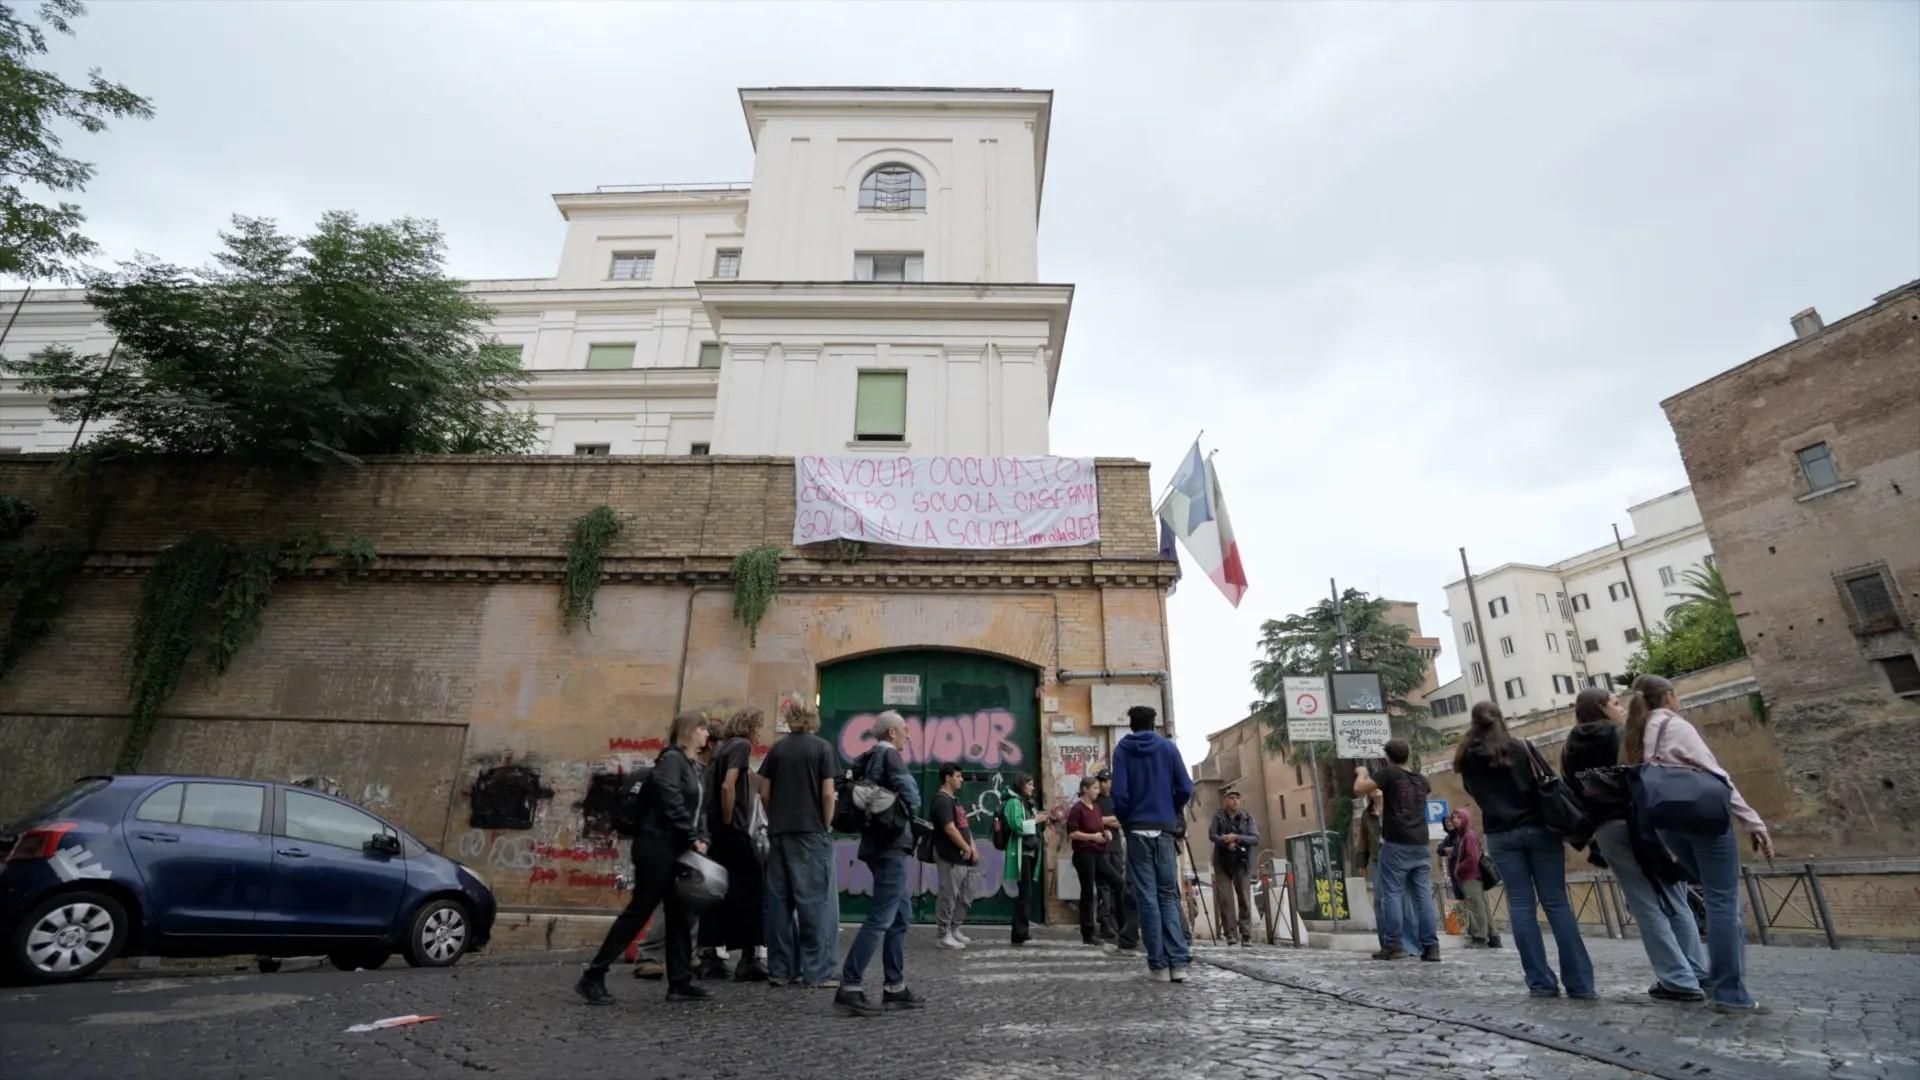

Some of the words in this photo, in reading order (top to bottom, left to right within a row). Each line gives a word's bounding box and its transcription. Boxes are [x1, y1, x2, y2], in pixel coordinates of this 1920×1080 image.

[801, 456, 914, 488] CAVOUR
[929, 456, 1081, 487] OCCUPATO
[800, 484, 896, 511] CONTRO
[912, 491, 1004, 514] SCUOLA
[798, 506, 865, 538] SOLDI
[881, 515, 941, 545] ALLA
[947, 518, 1028, 546] SCUOLA
[1338, 728, 1388, 737] ettronico
[1342, 718, 1383, 726] controllo
[839, 708, 1024, 769] CVOUR
